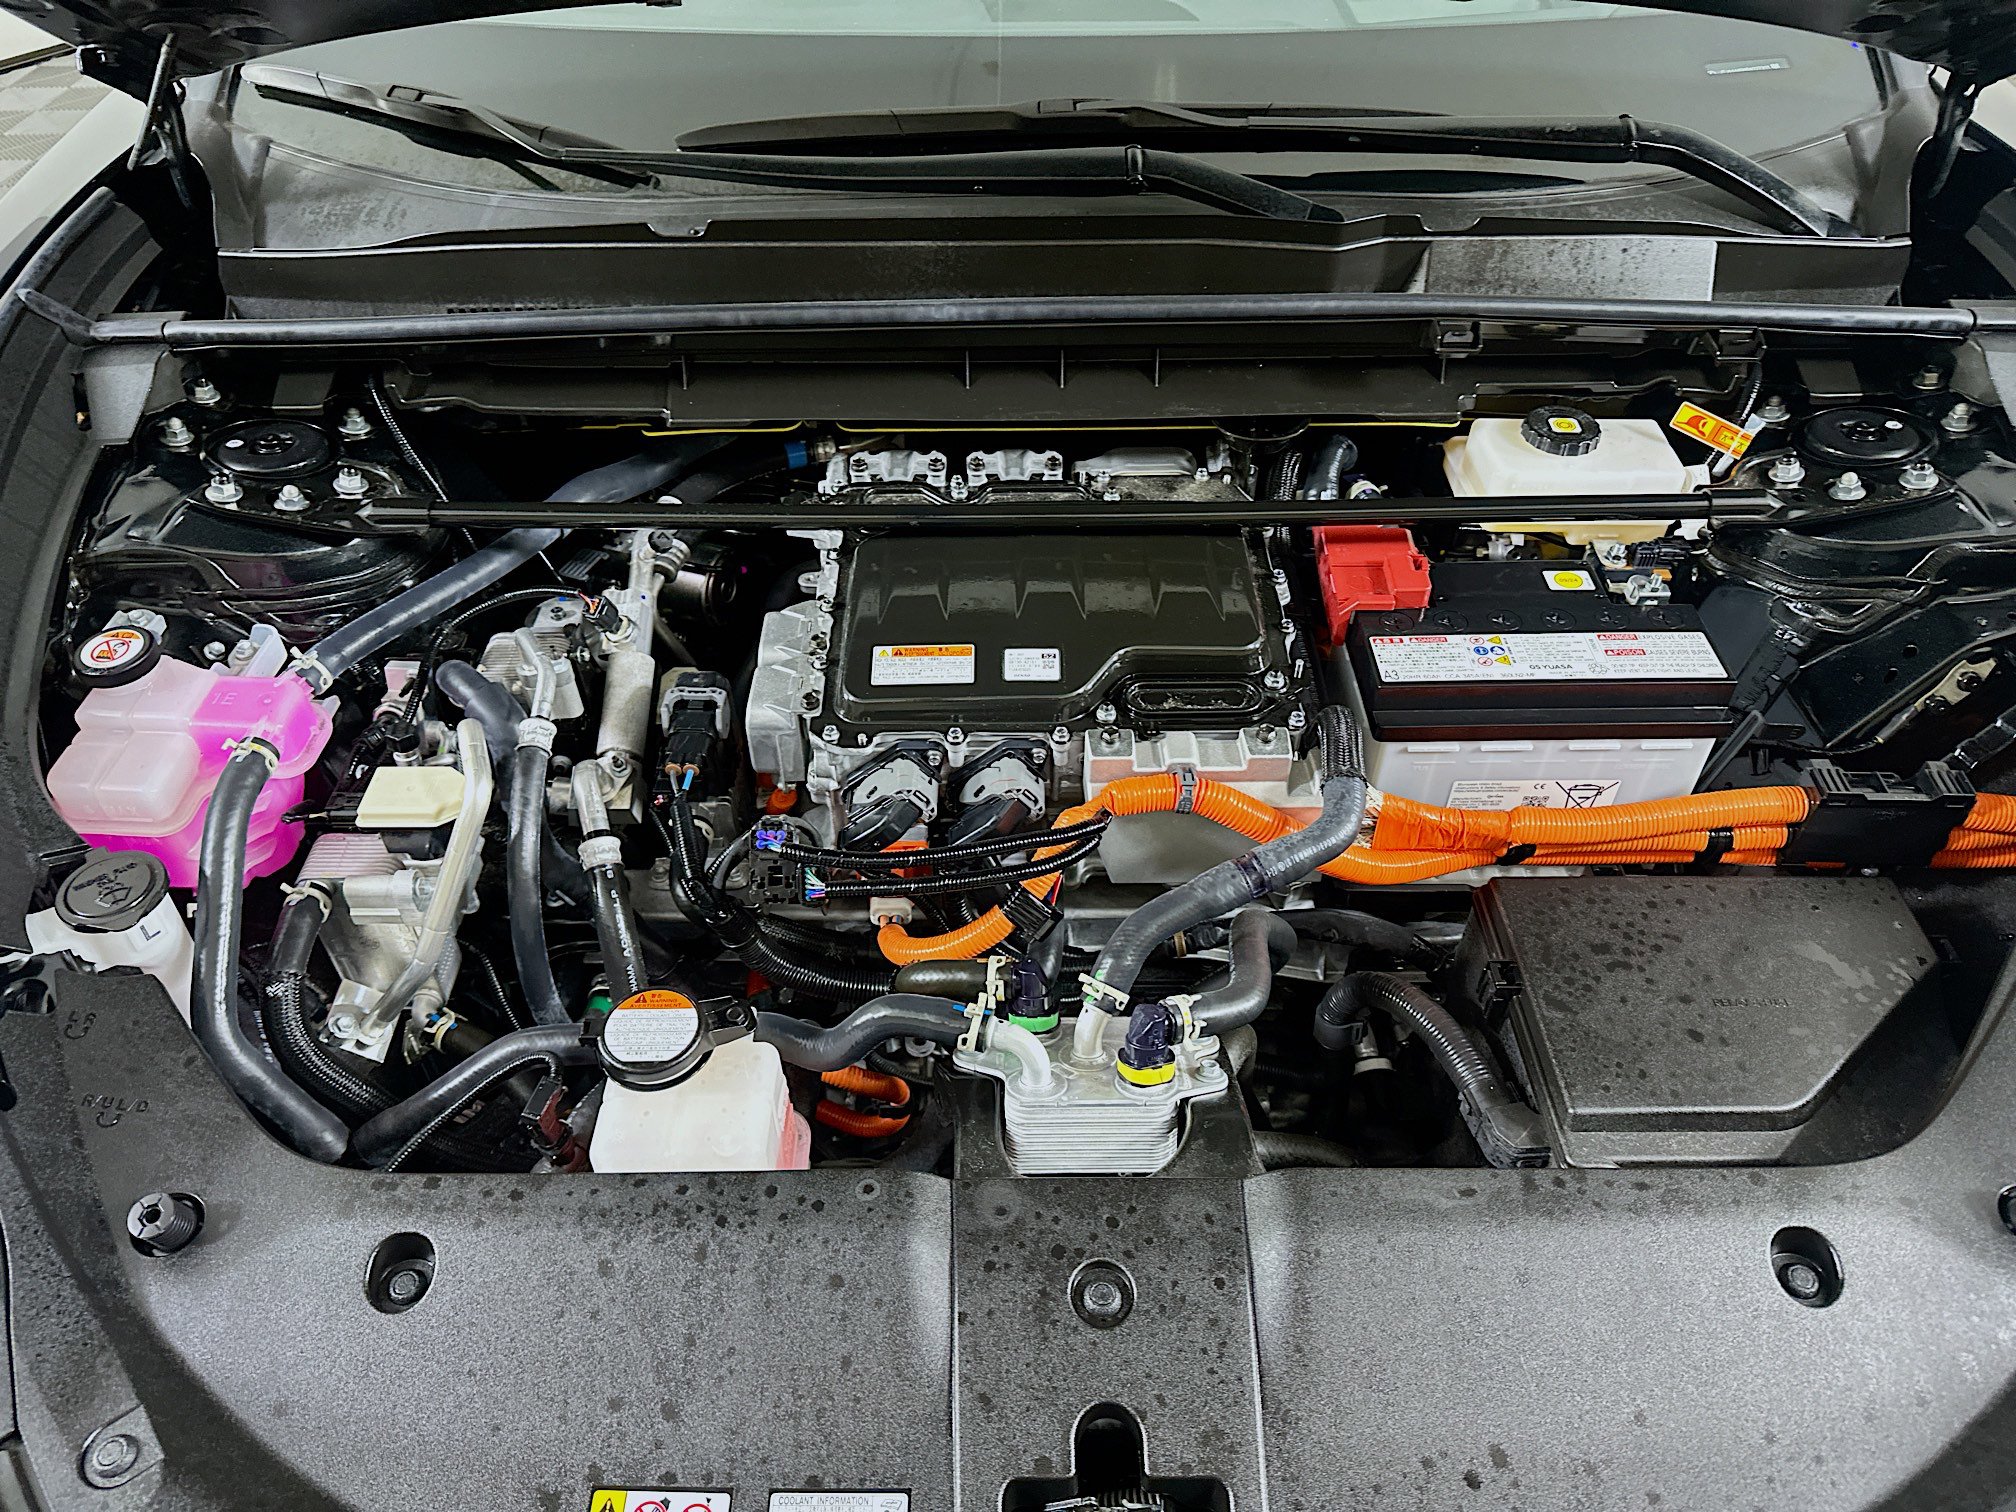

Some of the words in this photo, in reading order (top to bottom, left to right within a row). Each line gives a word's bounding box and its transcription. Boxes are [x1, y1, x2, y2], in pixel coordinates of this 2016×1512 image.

[1384, 670, 1399, 680] A3
[140, 924, 161, 941] L
[778, 1496, 814, 1505] COOLANT
[817, 1496, 869, 1505] INFORMATION
